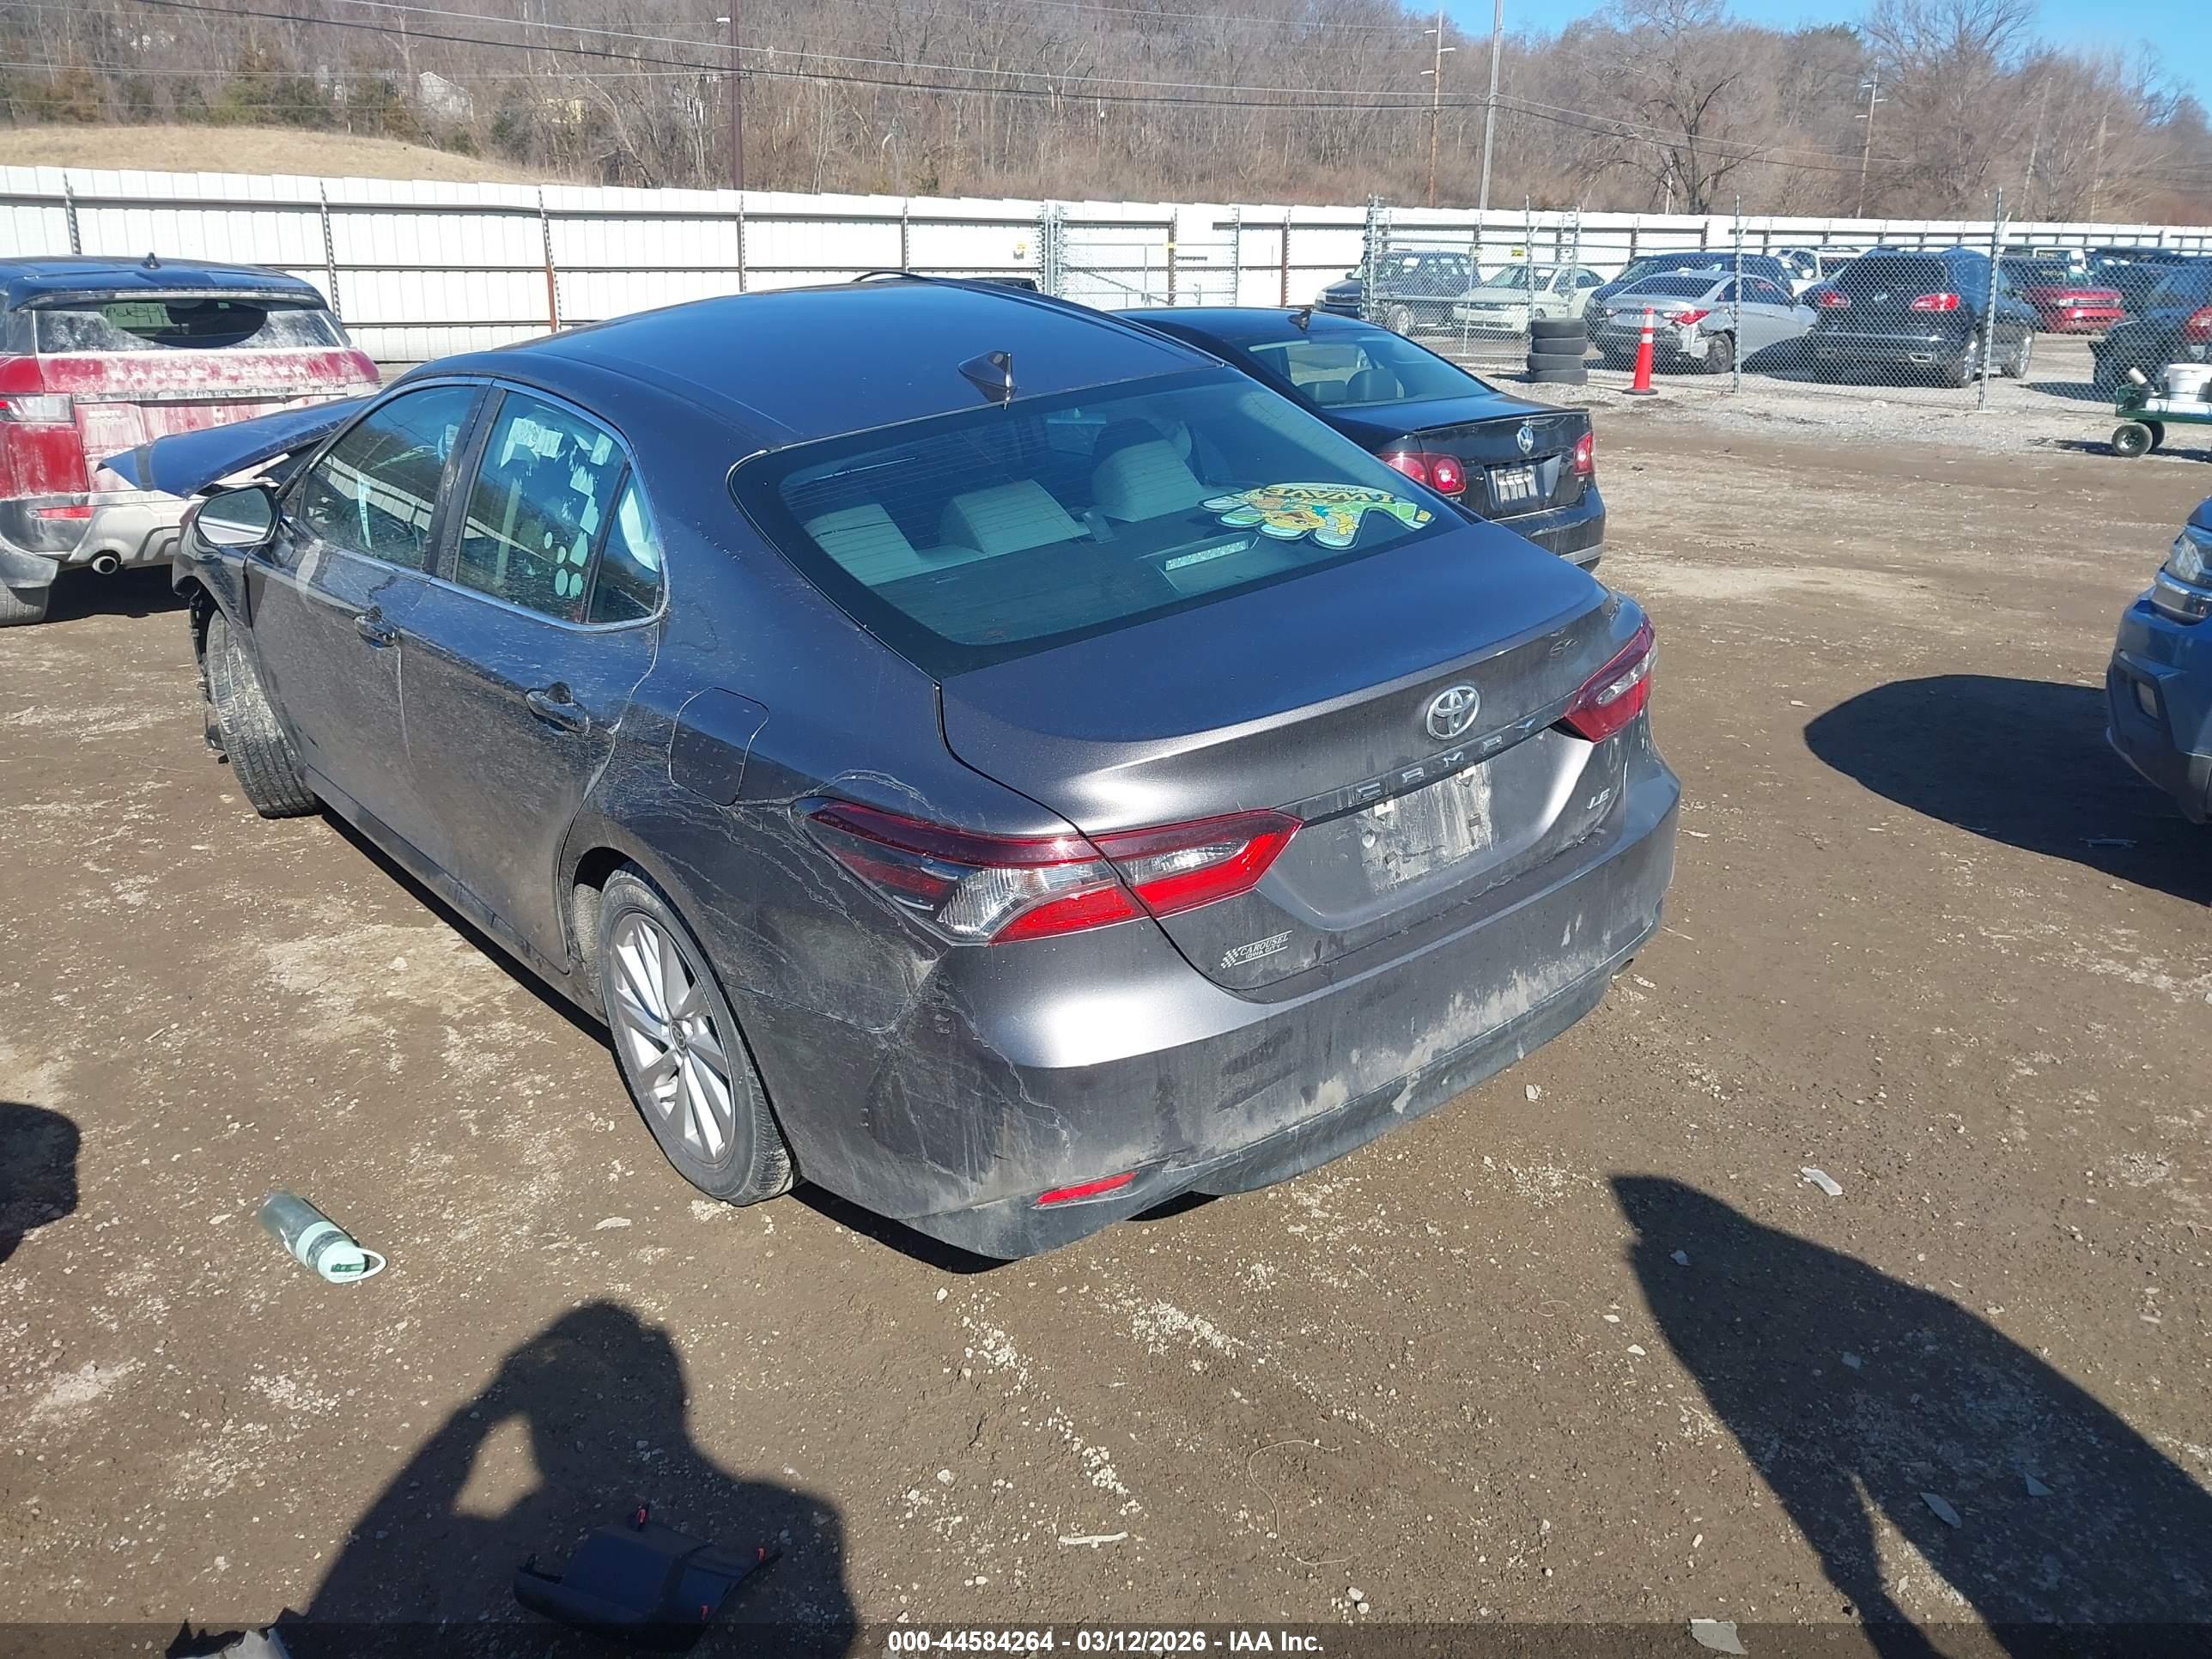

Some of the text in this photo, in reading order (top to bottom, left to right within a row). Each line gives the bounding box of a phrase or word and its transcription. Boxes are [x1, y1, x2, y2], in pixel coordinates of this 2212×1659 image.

[1263, 486, 1376, 502] WAVE
[1354, 717, 1538, 800] CAMRY
[1586, 787, 1611, 810] LE
[1240, 933, 1289, 956] CAROUSEL
[1245, 944, 1281, 959] IOWA CITY
